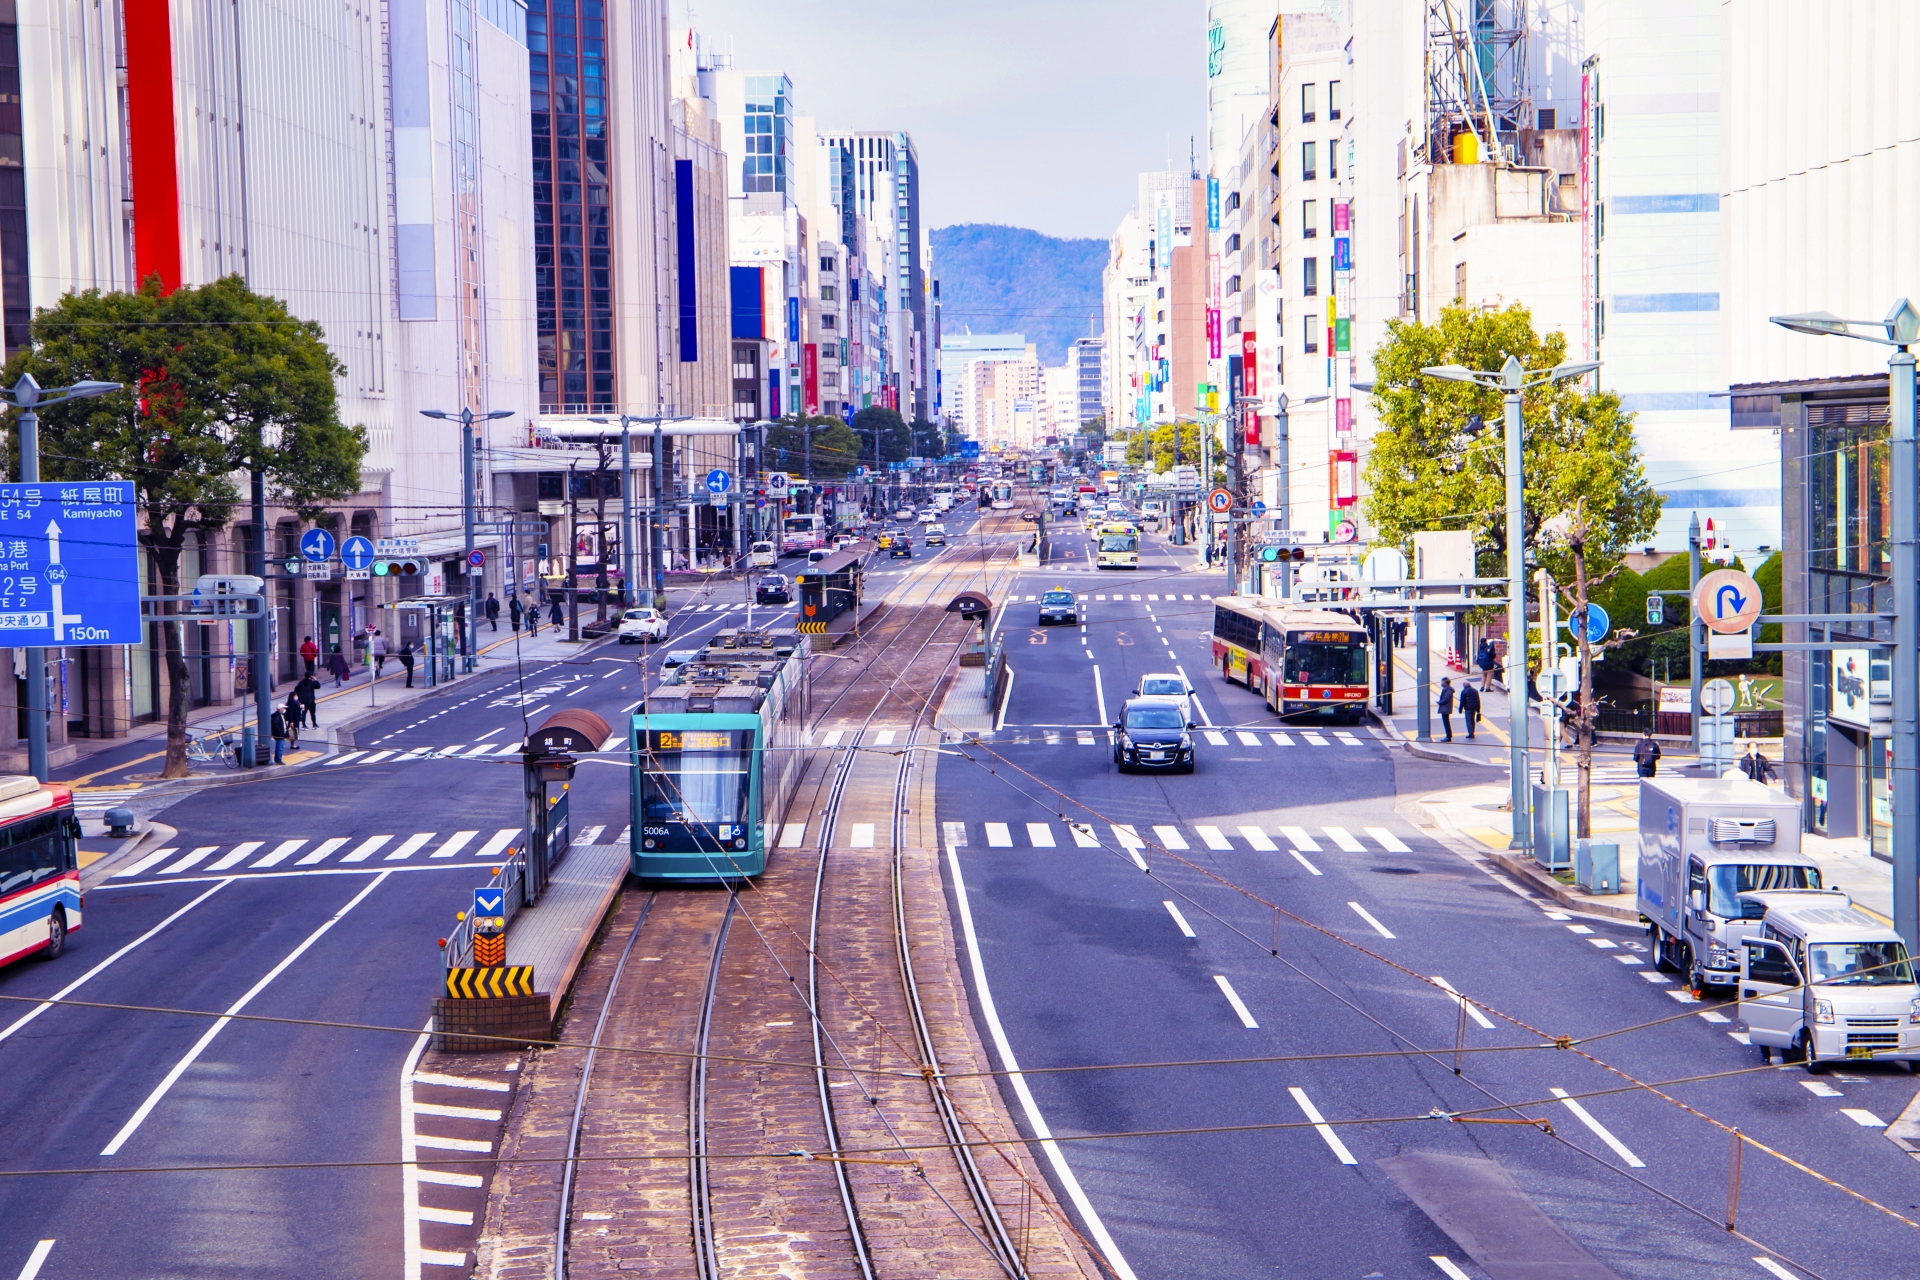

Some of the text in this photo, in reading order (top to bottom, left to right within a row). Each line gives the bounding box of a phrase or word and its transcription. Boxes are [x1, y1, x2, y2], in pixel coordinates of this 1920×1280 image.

[1, 488, 43, 508] 54号
[60, 487, 123, 506] 紙屋町
[17, 510, 31, 520] 54
[63, 508, 122, 520] Kamiyacho
[10, 560, 29, 571] Port
[48, 569, 65, 580] 164
[3, 577, 38, 596] 2号
[19, 597, 26, 607] 2
[69, 626, 109, 641] 150m
[661, 734, 671, 746] 2
[696, 737, 730, 748] 宮島口
[643, 826, 669, 836] 5006A
